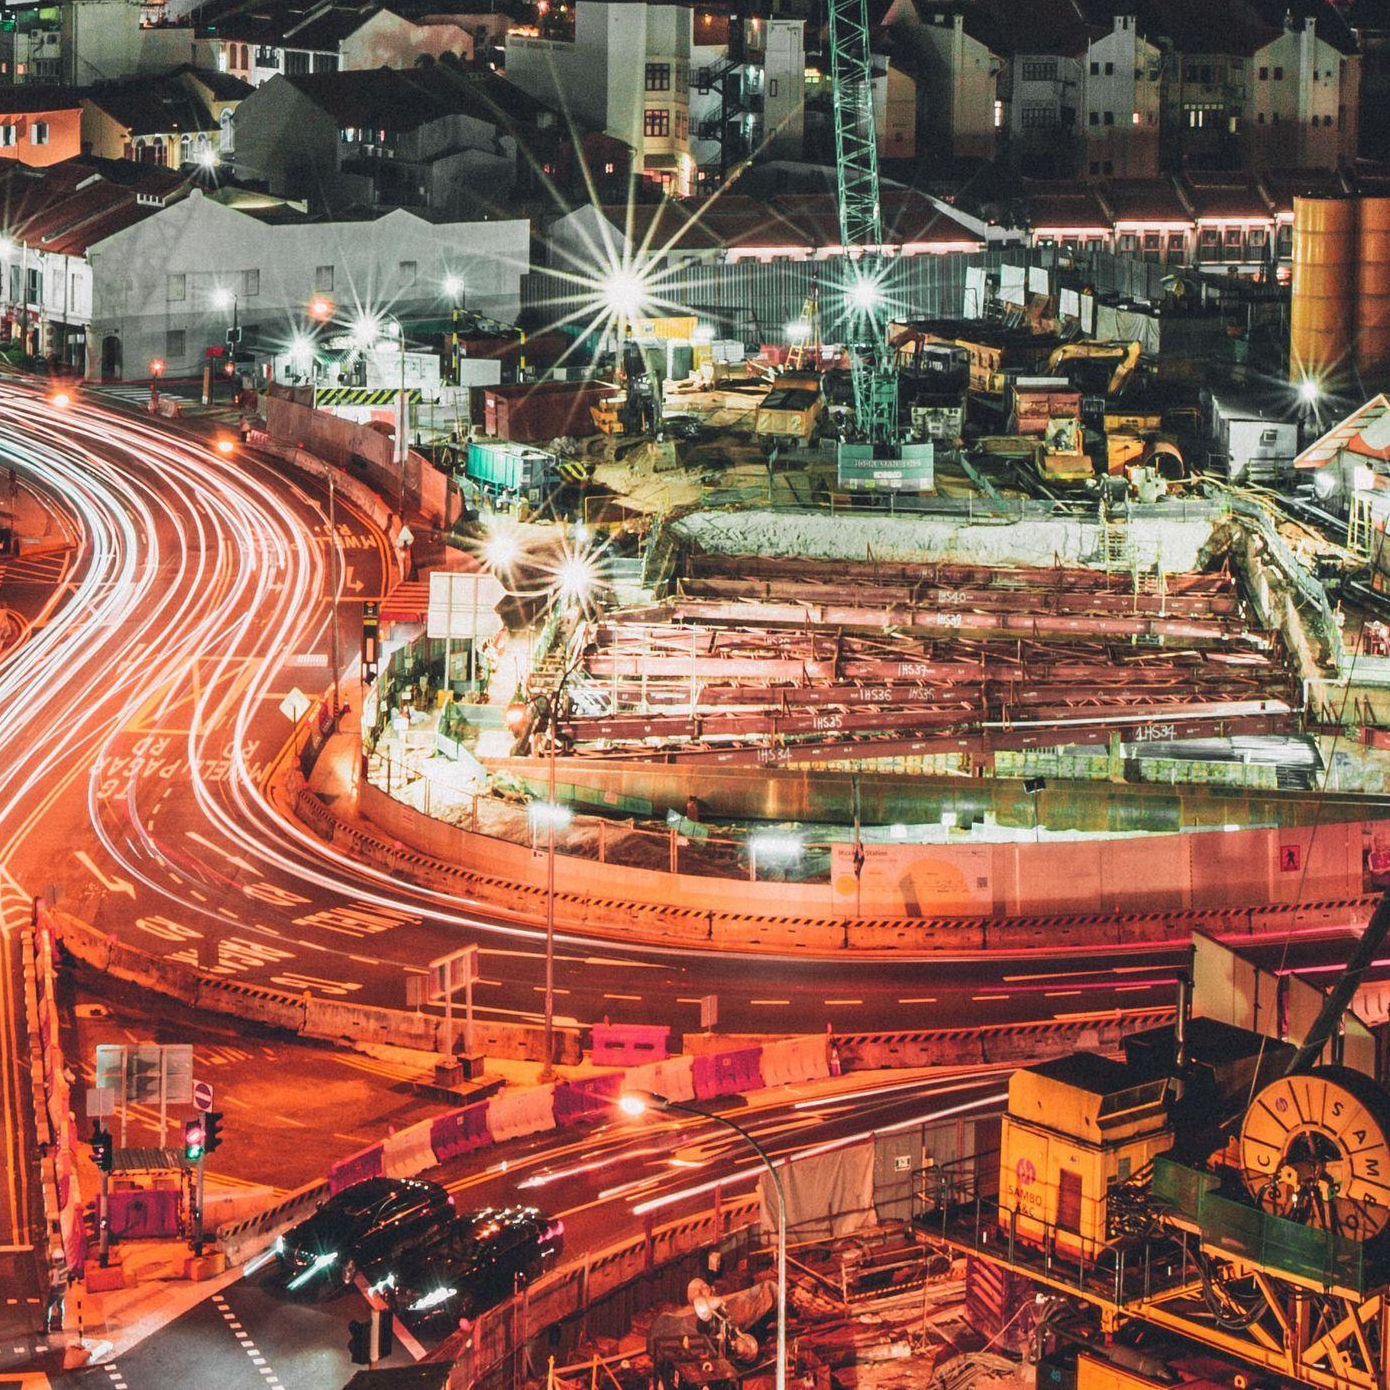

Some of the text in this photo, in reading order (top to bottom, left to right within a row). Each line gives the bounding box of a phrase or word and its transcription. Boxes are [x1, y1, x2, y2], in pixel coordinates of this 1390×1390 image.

[860, 688, 893, 702] 1HS36
[812, 714, 843, 730] 1HS35
[1135, 723, 1177, 742] 1HS34
[131, 737, 171, 757] RD
[756, 746, 793, 761] 1HS34
[1008, 1185, 1042, 1207] SAMBO
